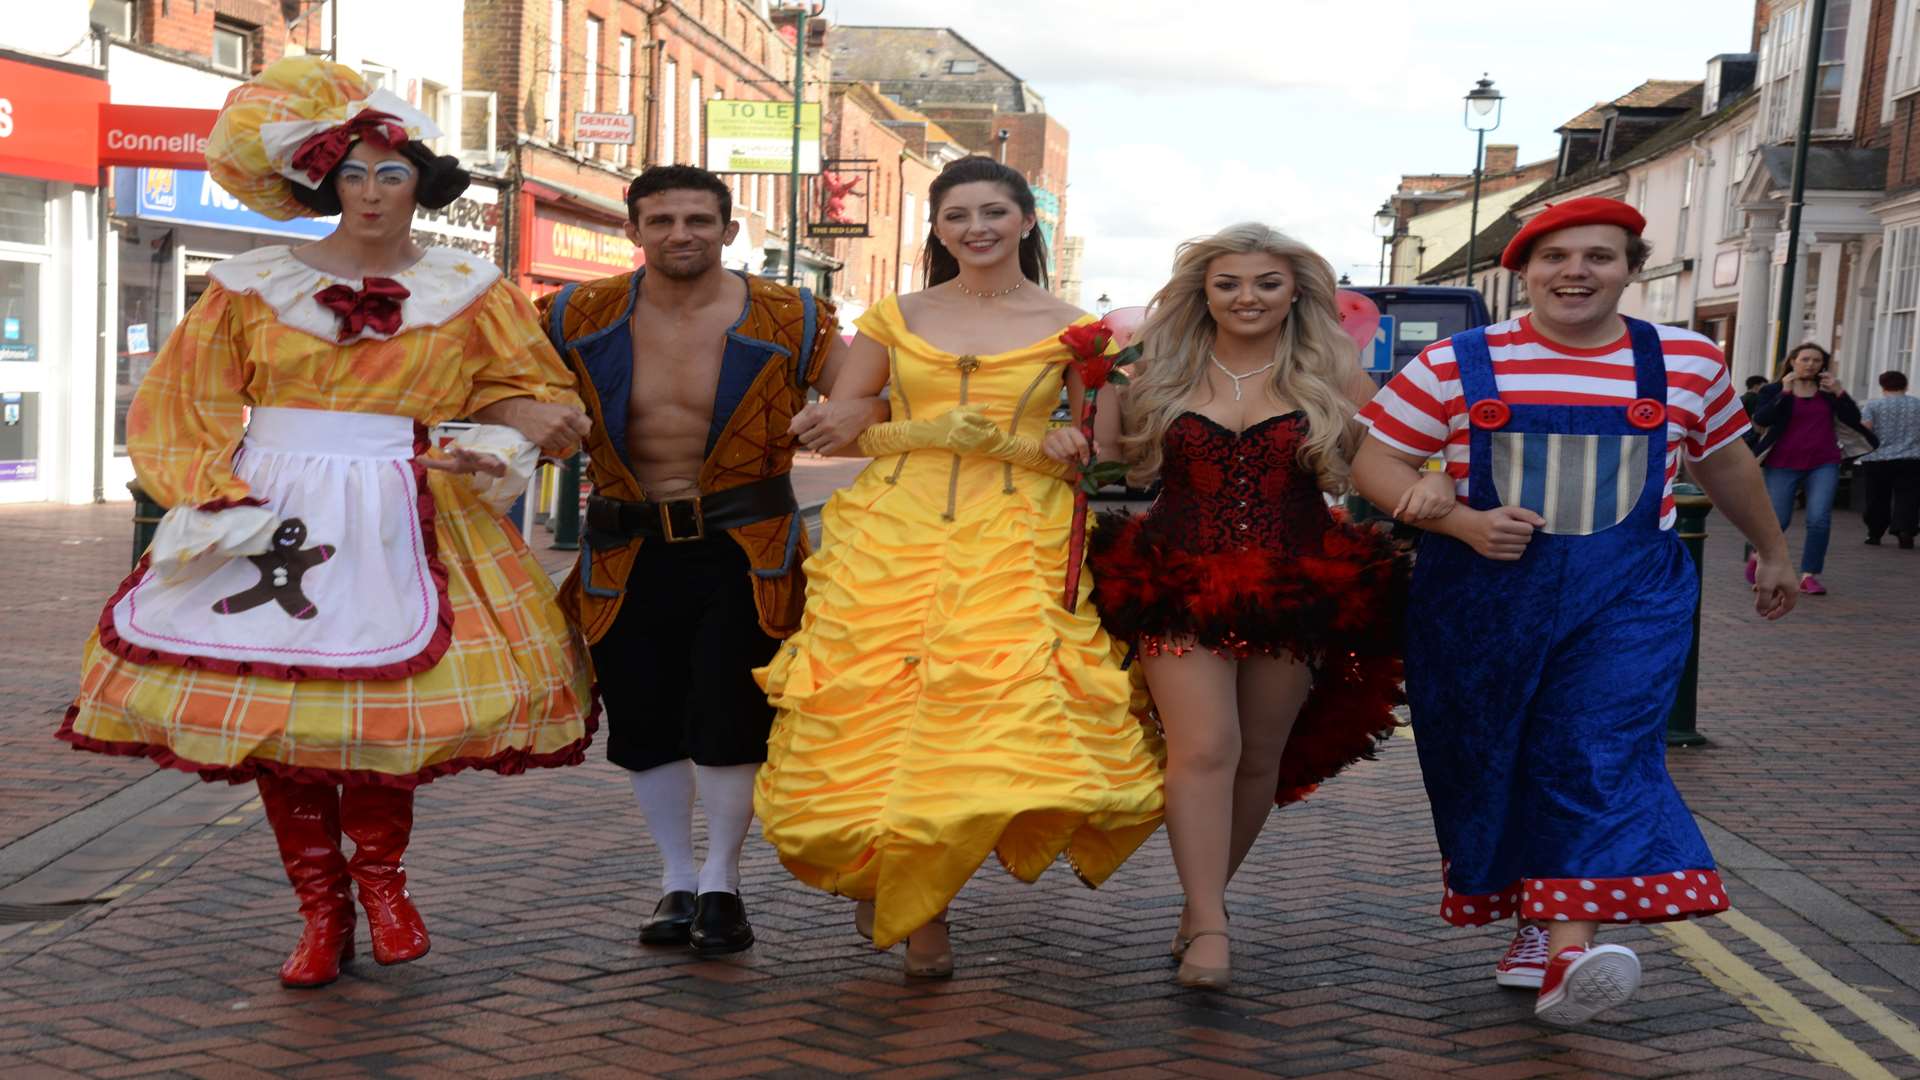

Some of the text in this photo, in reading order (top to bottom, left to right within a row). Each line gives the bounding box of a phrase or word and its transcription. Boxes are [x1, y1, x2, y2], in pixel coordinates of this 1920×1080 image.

[728, 103, 795, 119] TO LE
[580, 115, 628, 128] DENTAL
[107, 128, 208, 153] Connells
[577, 128, 632, 141] SURGERY
[812, 226, 865, 234] THE RED LION
[552, 222, 598, 262] OLYMPIA
